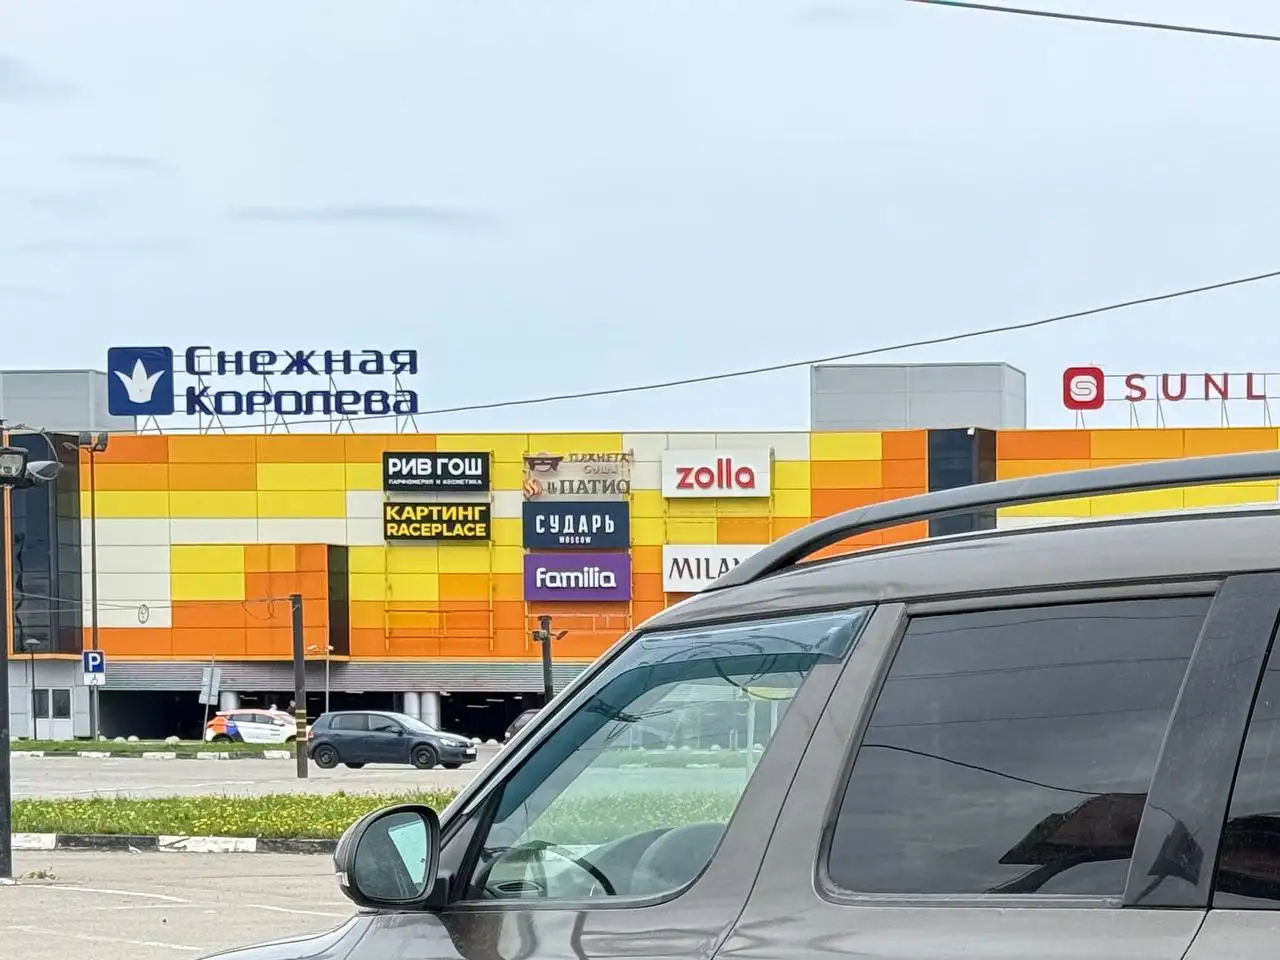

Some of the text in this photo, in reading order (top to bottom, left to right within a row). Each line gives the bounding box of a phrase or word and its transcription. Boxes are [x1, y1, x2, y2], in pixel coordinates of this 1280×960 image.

[185, 345, 418, 375] Снежная
[186, 385, 418, 415] Королева
[388, 458, 482, 475] РИВ ГОШ
[676, 458, 755, 489] zolla
[386, 506, 486, 520] КАРТИНГ
[387, 523, 486, 536] RACEPLACE
[536, 514, 615, 533] СУДАРЬ
[88, 653, 101, 671] P
